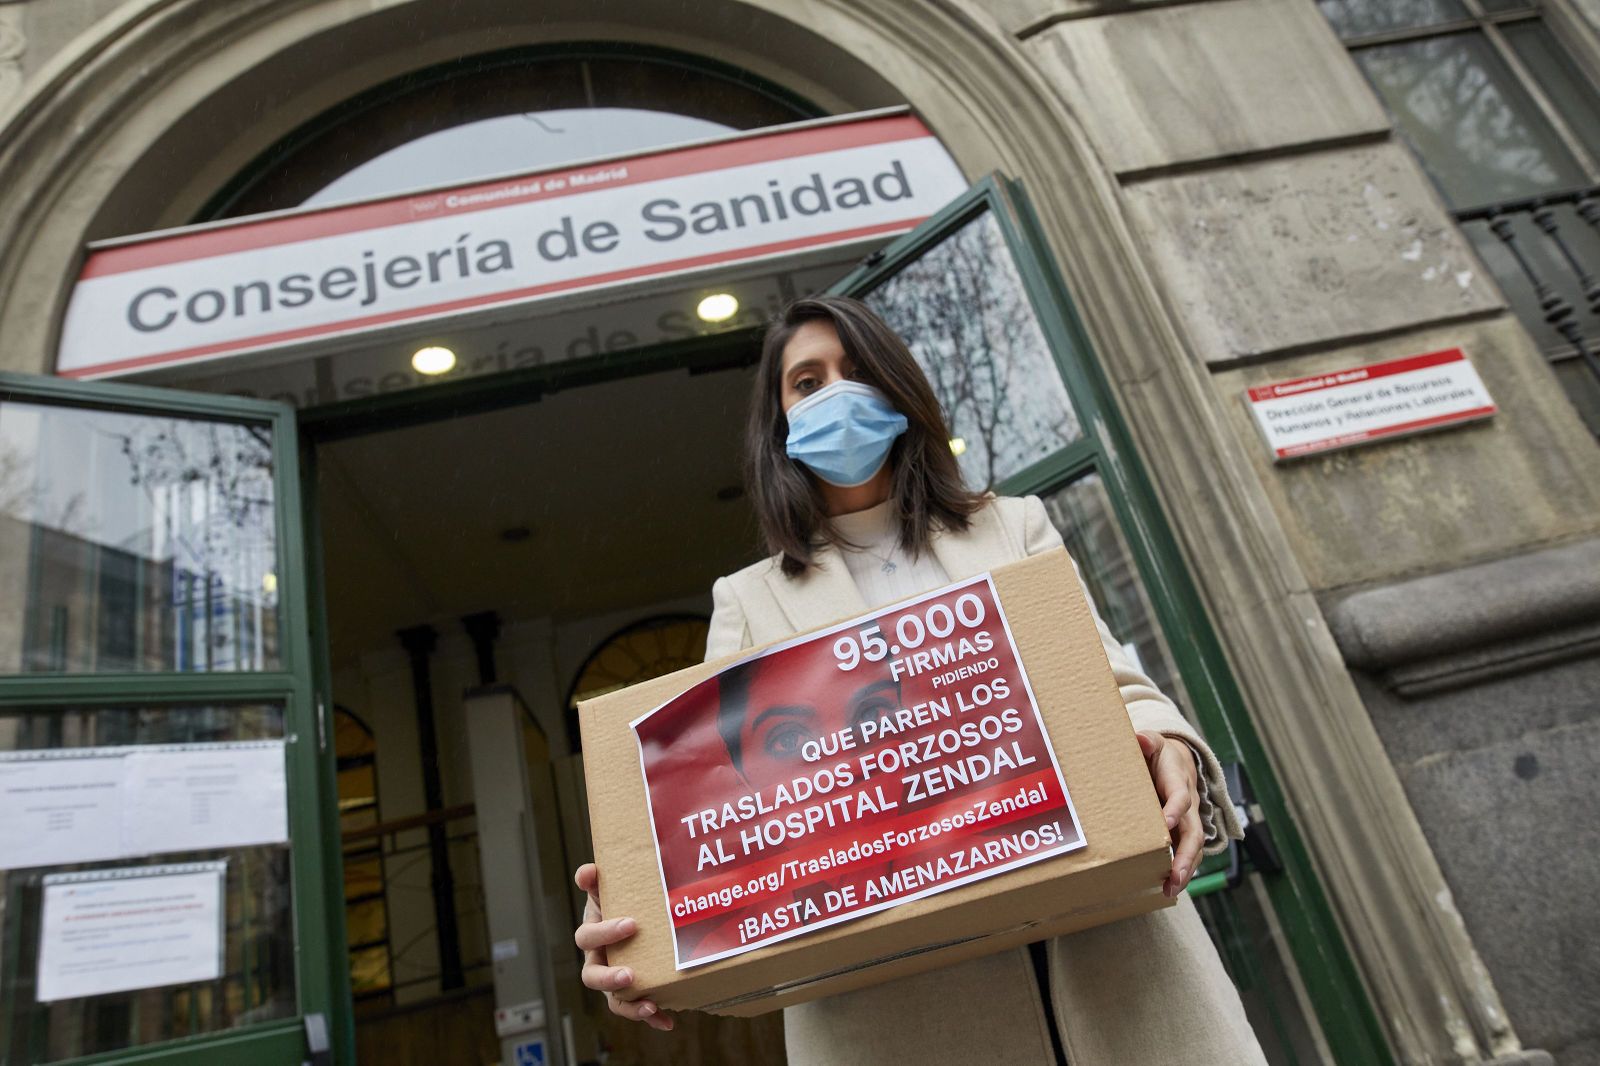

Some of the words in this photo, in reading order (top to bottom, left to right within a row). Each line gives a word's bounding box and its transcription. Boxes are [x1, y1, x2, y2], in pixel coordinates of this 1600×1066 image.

[446, 182, 541, 208] Comunidad
[544, 177, 566, 192] de
[569, 168, 628, 187] Madrid
[126, 232, 514, 333] Consejería
[537, 216, 620, 262] de
[641, 160, 913, 242] Sanidad
[1266, 402, 1325, 420] Dirección
[1326, 391, 1374, 409] General
[1377, 388, 1392, 398] de
[1394, 376, 1453, 394] Recursos
[1273, 416, 1332, 435] Humanos
[1344, 401, 1412, 421] Relaciones
[1412, 387, 1475, 408] Laborales
[832, 593, 985, 671] 95.000
[890, 631, 993, 682] FIRMAS
[932, 657, 999, 688] PIDIENDO
[800, 726, 856, 762] QUE
[860, 696, 951, 743] PAREN
[955, 678, 1010, 712] LOS
[681, 763, 855, 838] TRASLADOS
[859, 709, 1022, 780] FORZOSOS
[697, 838, 735, 871] AL
[741, 786, 898, 855] HOSPITAL
[902, 741, 1036, 803] ZENDAL
[675, 782, 1048, 917] change.org/TrasladosForzososZendal
[738, 897, 821, 943] ¡BASTA
[823, 885, 858, 914] DE
[866, 821, 1065, 900] AMENAZARNOS!
